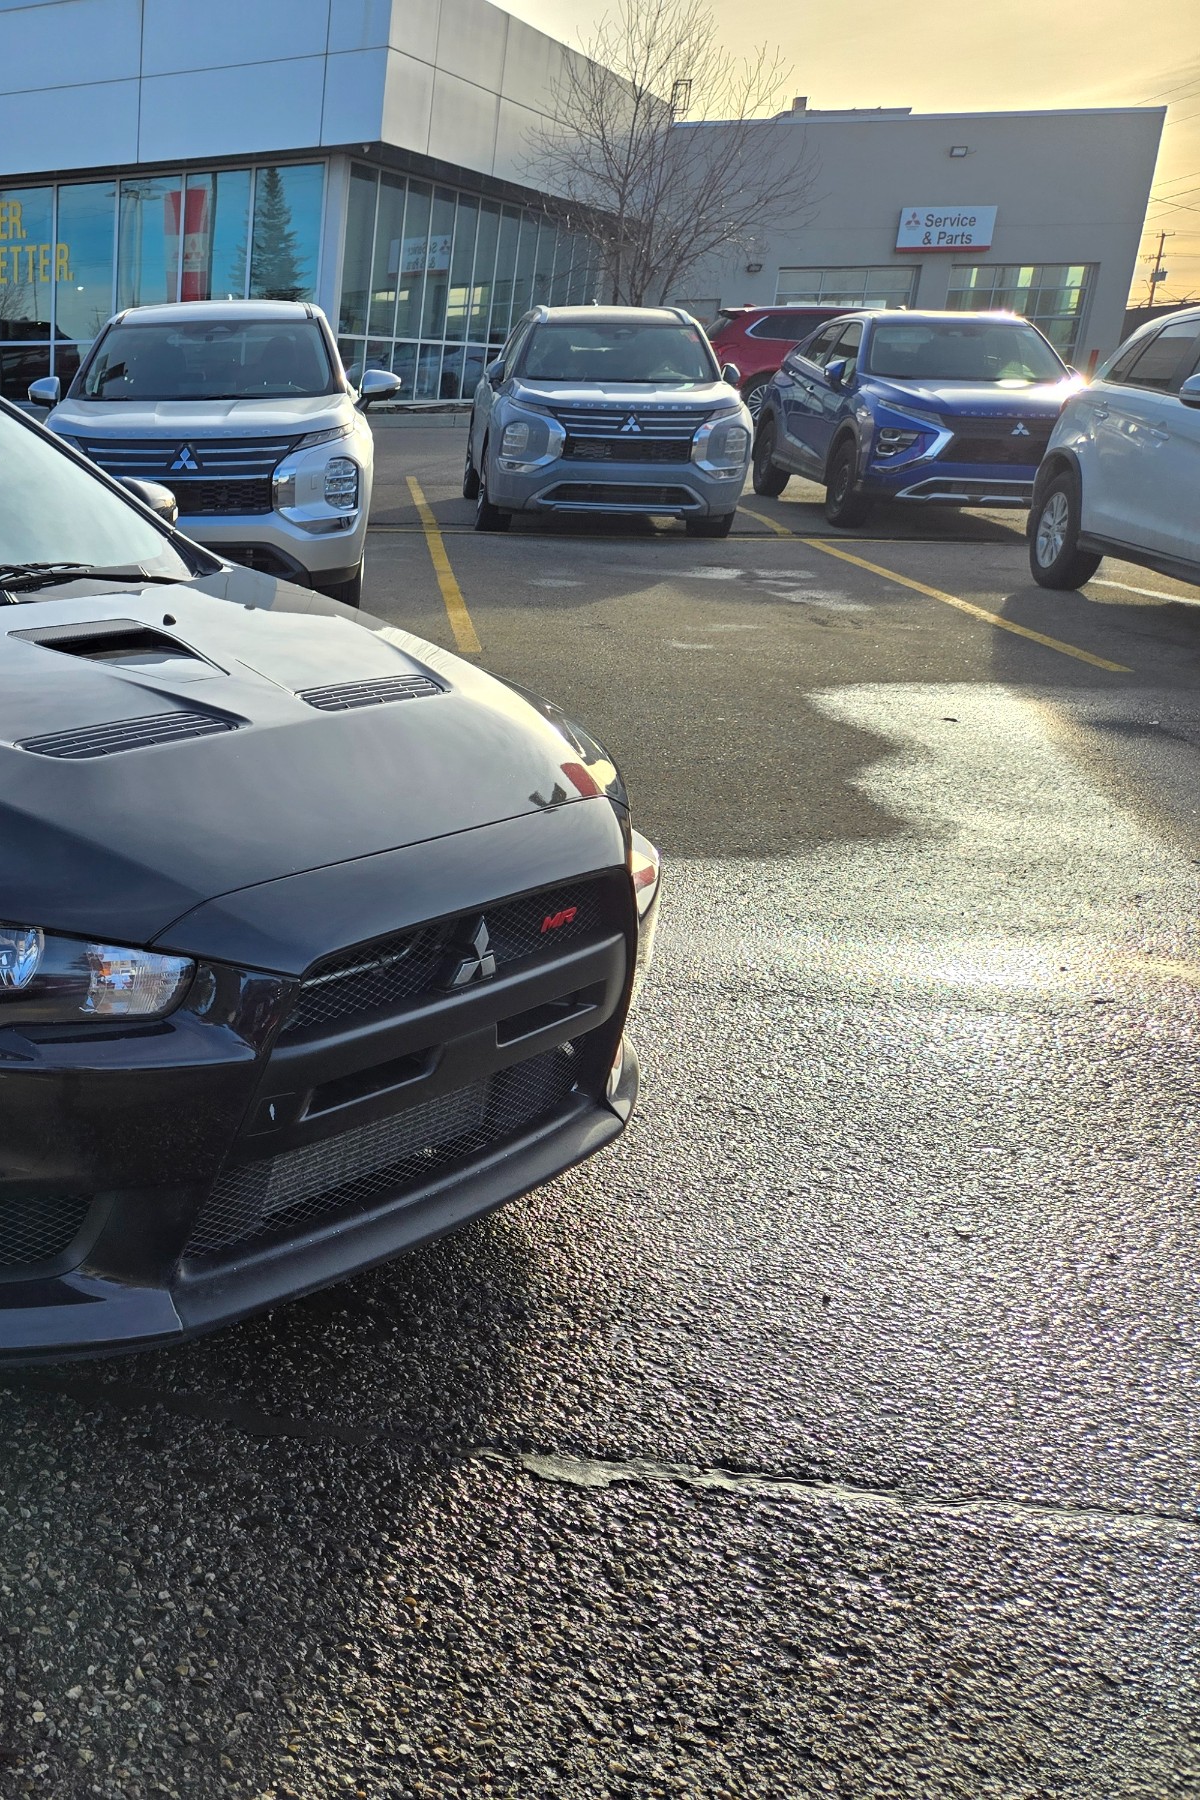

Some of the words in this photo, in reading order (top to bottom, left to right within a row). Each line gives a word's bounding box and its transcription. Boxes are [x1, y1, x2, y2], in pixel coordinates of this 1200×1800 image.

[924, 213, 977, 228] Service
[922, 231, 932, 245] &
[936, 231, 973, 245] Parts
[572, 402, 692, 410] OUTLANDER
[540, 906, 578, 934] MR
